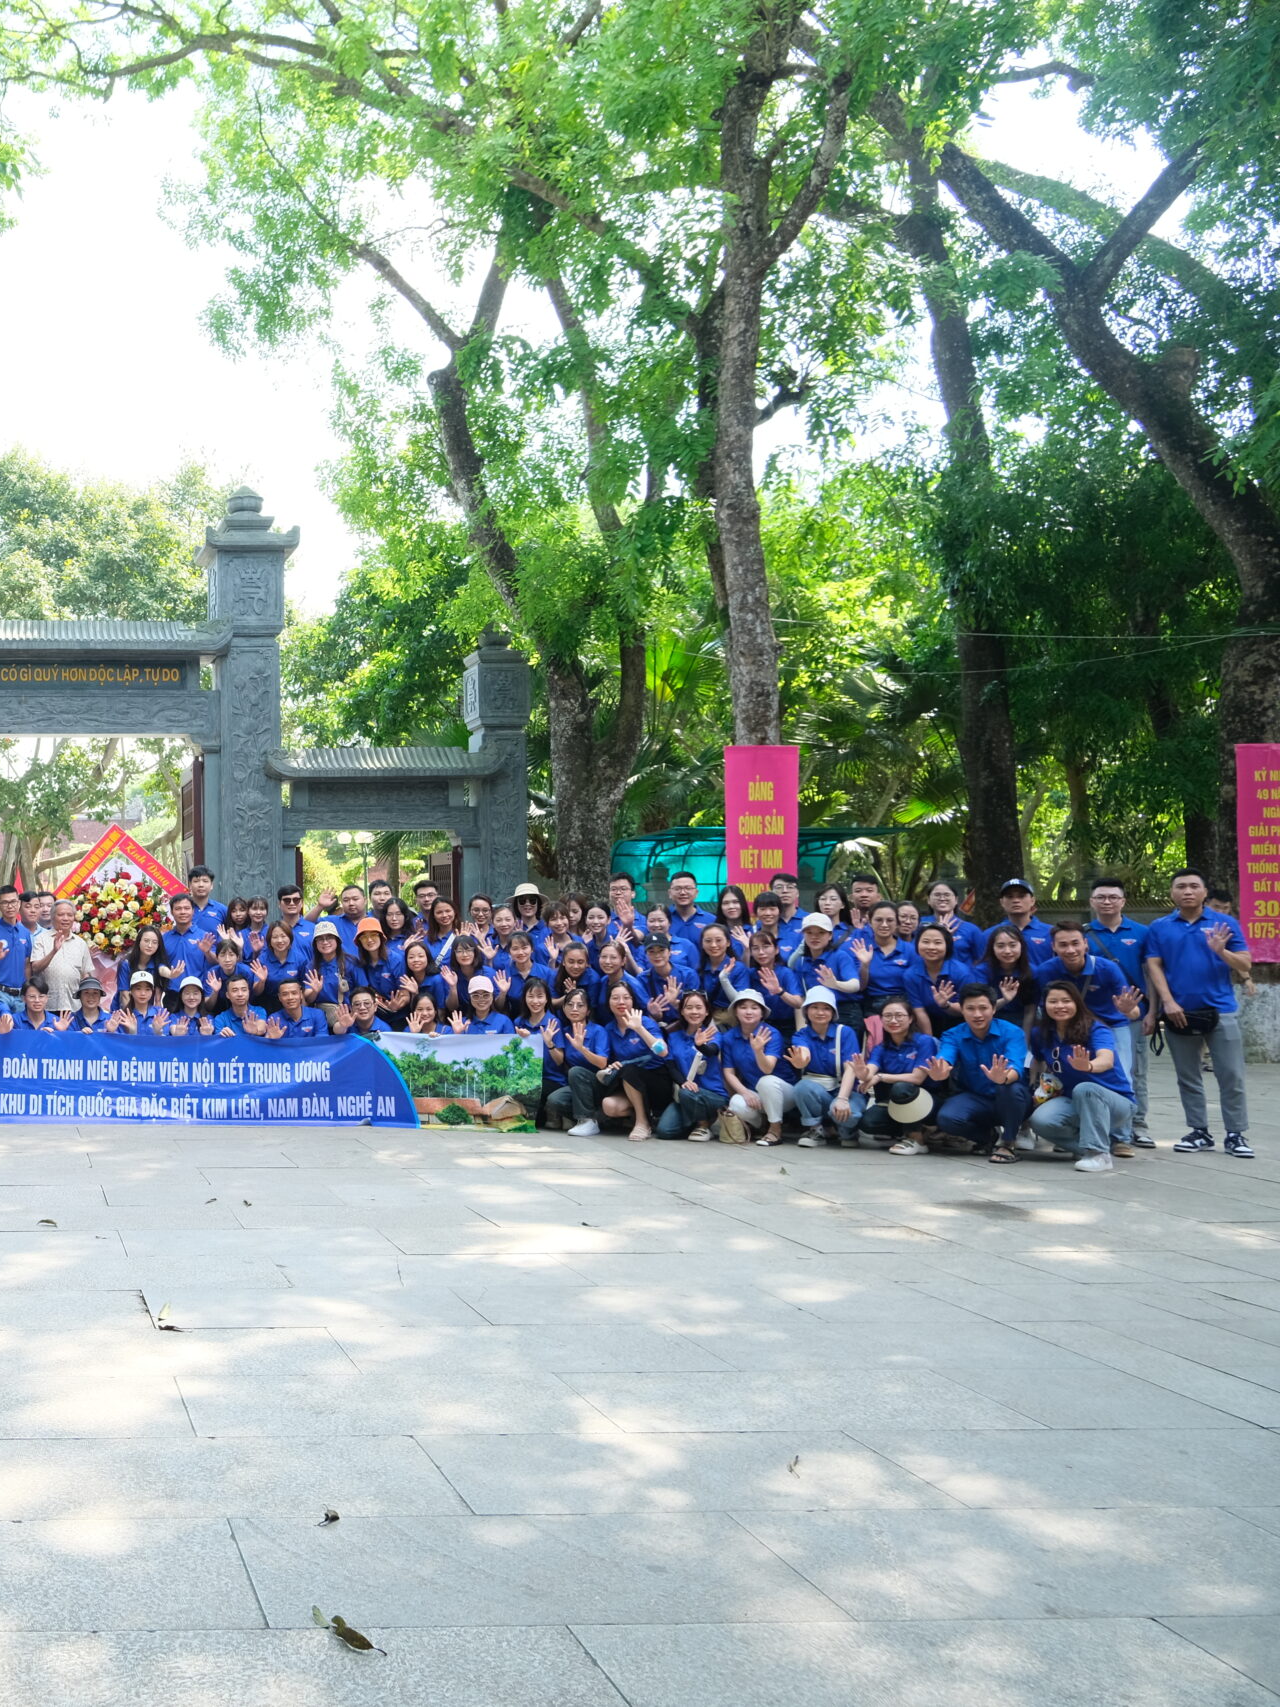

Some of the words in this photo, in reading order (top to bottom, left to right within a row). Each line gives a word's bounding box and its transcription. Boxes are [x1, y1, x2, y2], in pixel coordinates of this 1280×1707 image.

[1, 664, 18, 681] CÓ
[20, 664, 32, 681] GÌ
[34, 664, 58, 682] QUÝ
[61, 667, 86, 681] HƠN
[89, 664, 114, 686] ĐỘC
[144, 667, 160, 686] TỰ
[162, 668, 179, 682] DO
[748, 774, 774, 801] ĐẢNG
[1256, 788, 1269, 800] 49
[738, 811, 763, 840] CỘNG
[764, 808, 785, 835] SẢN
[1248, 822, 1268, 837] GIẢI
[740, 845, 759, 873] VIỆT
[761, 849, 783, 869] NAM
[1246, 858, 1279, 874] THỐNG
[1253, 877, 1272, 892] ĐẤT
[2, 1053, 38, 1079] ĐOÀN
[42, 1058, 83, 1081] THANH
[86, 1056, 118, 1081] NIÊN
[121, 1056, 156, 1086] BỆNH
[159, 1057, 188, 1087] VIỆN
[192, 1058, 214, 1087] NỘI
[218, 1056, 244, 1083] TIẾT
[248, 1062, 291, 1083] TRUNG
[294, 1060, 330, 1082] ƯƠNG
[0, 1094, 26, 1114] KHU
[29, 1094, 42, 1115] DI
[46, 1090, 74, 1116] TÍCH
[78, 1088, 112, 1118] QUỐC
[116, 1096, 138, 1117] GIA
[141, 1092, 167, 1122] ĐẶC
[170, 1093, 199, 1122] BIỆT
[202, 1097, 226, 1118] KIM
[230, 1094, 264, 1120] LIÊN,
[268, 1097, 298, 1118] NAM
[302, 1093, 334, 1120] ĐÀN,
[376, 1096, 396, 1117] AN
